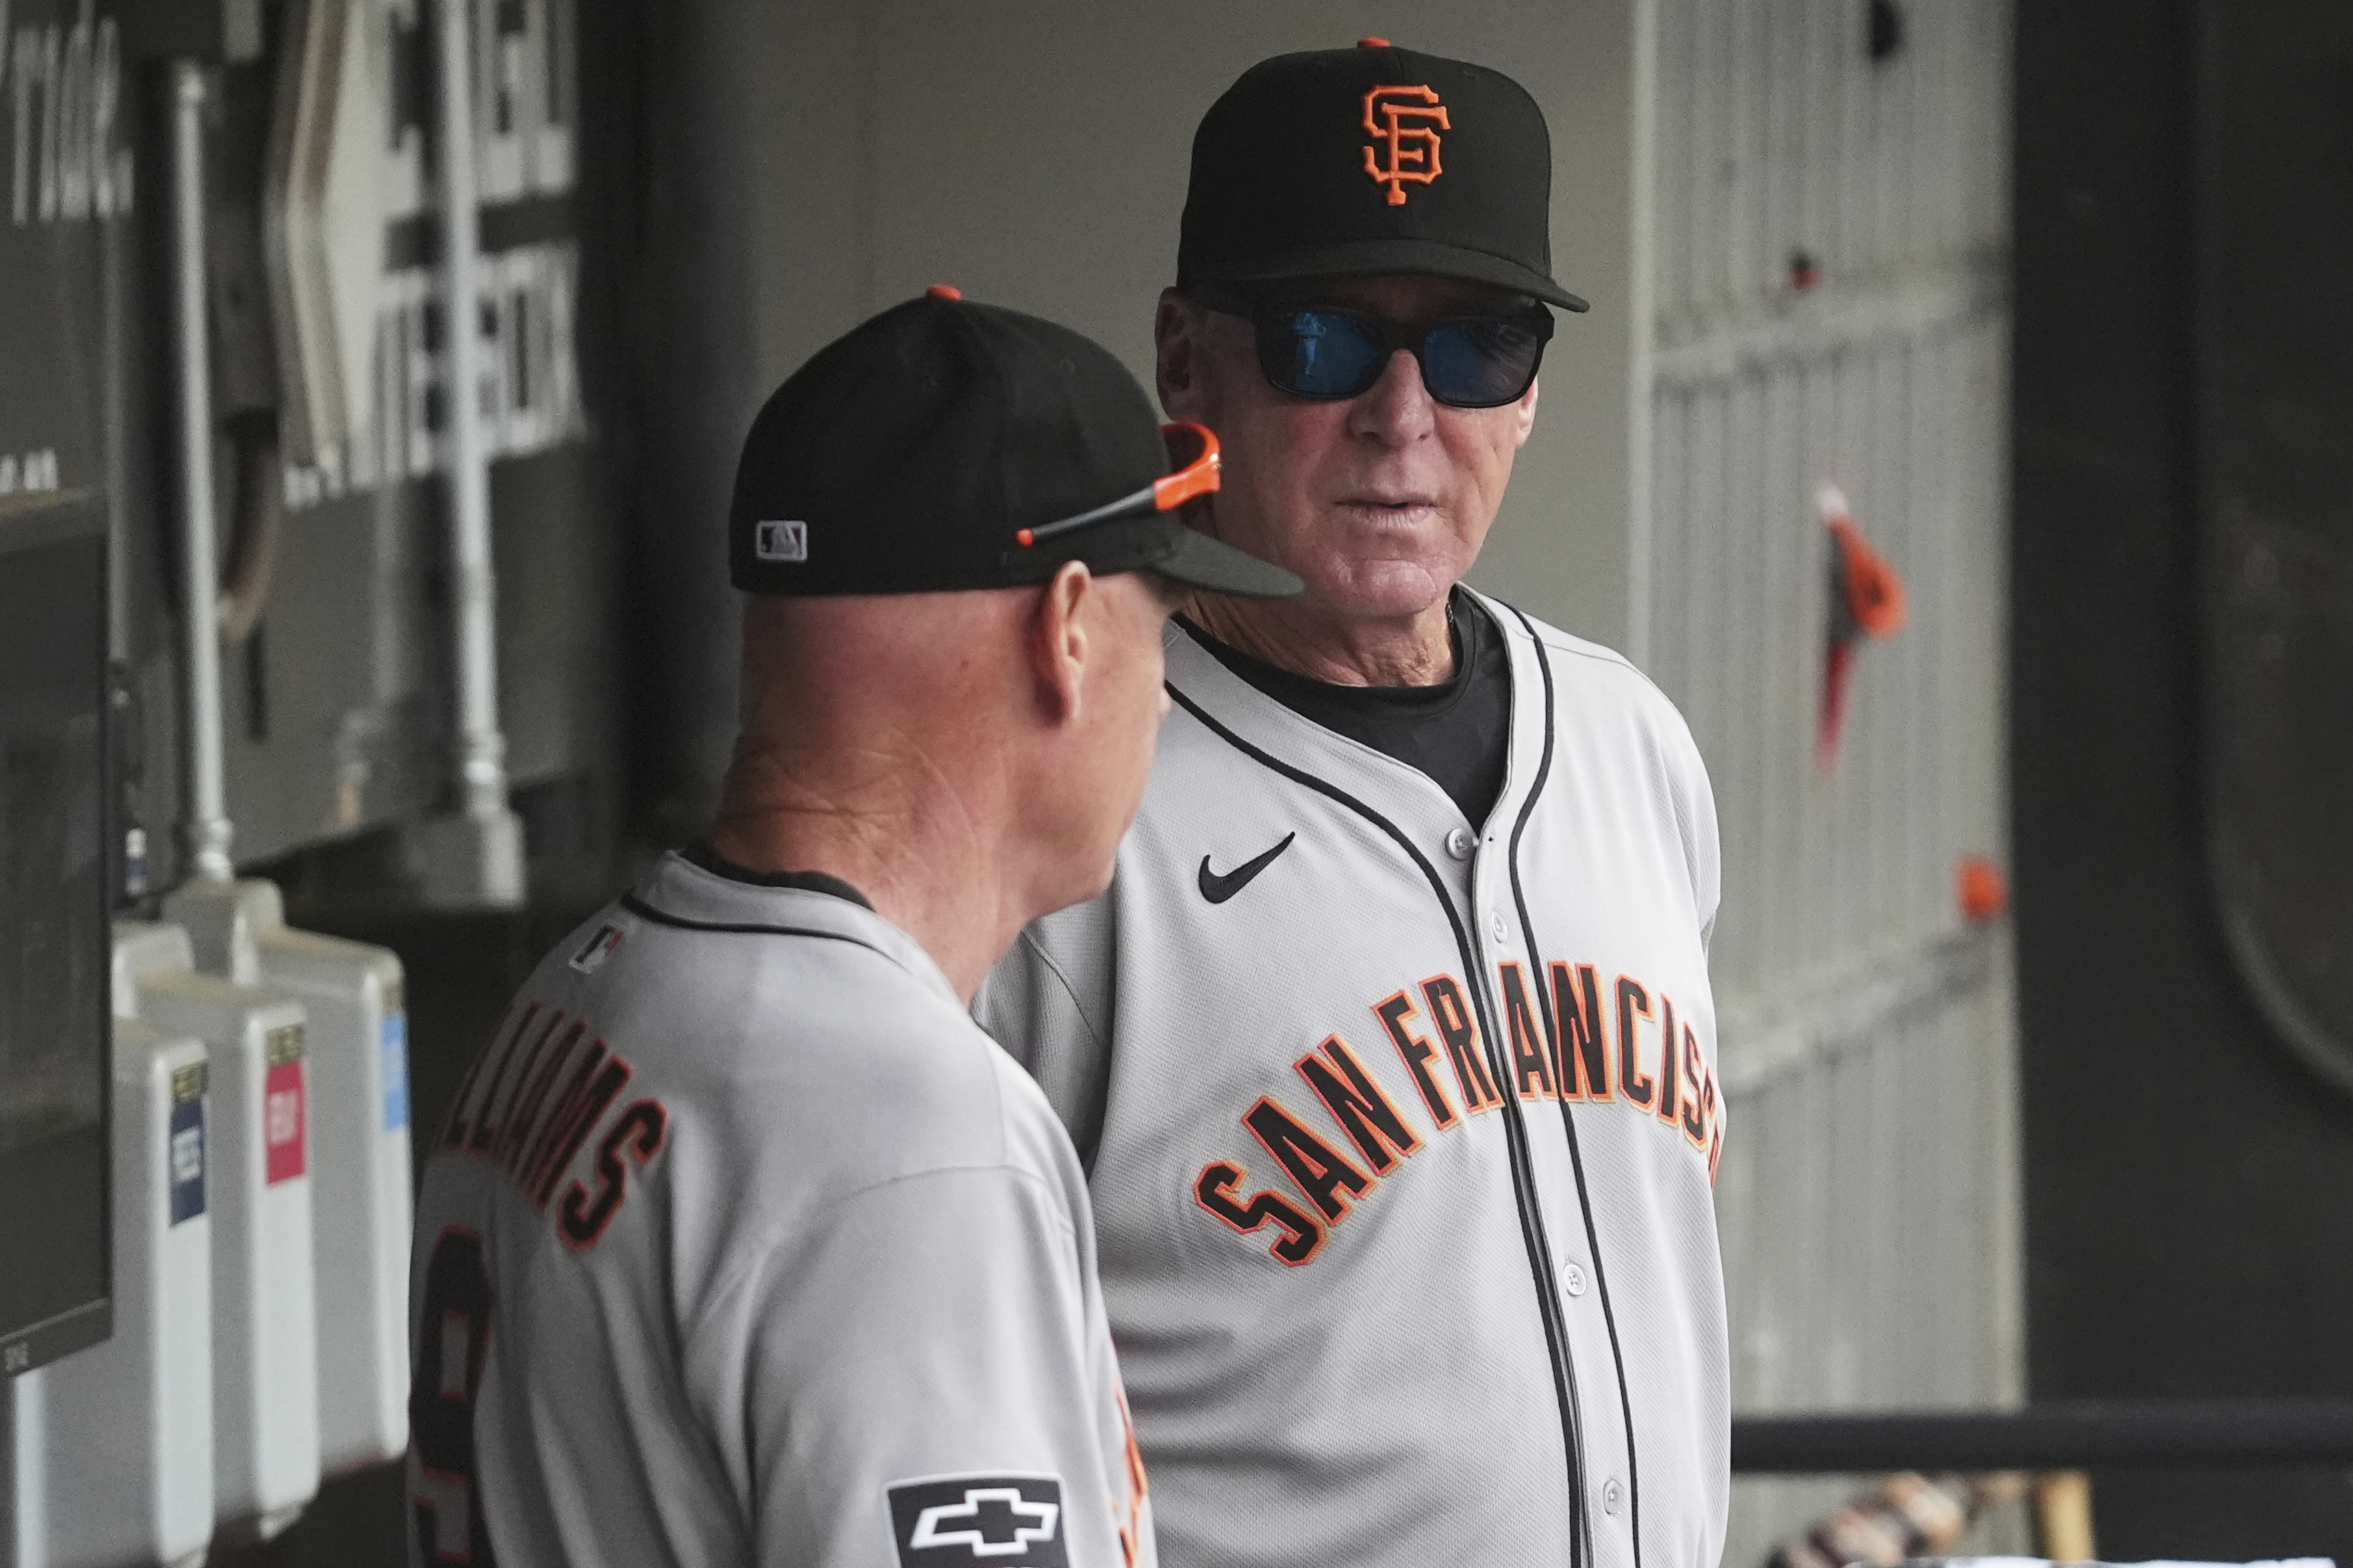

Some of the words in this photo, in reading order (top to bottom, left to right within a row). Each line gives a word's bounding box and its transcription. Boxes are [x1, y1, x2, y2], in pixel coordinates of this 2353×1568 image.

[1362, 84, 1451, 205] SF
[435, 1001, 667, 1251] LLIAMS
[1193, 1033, 1427, 1266] SAN
